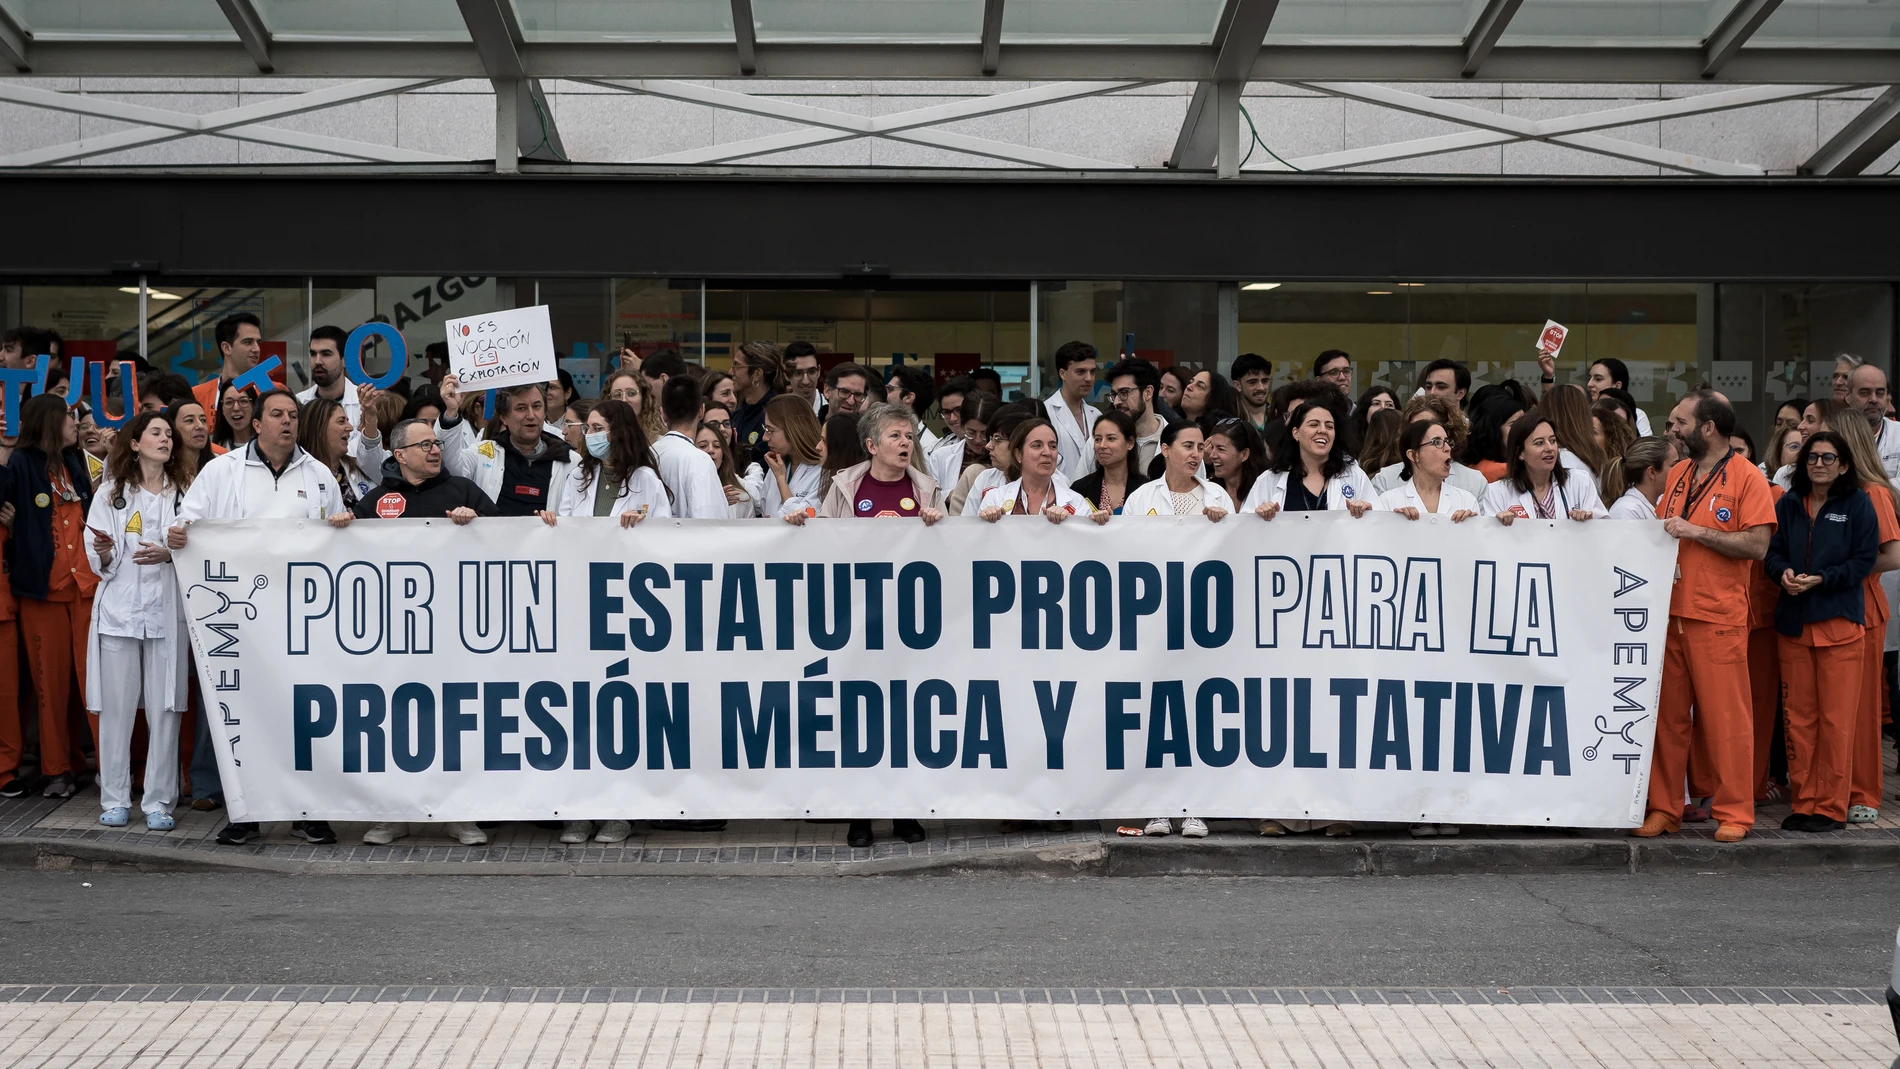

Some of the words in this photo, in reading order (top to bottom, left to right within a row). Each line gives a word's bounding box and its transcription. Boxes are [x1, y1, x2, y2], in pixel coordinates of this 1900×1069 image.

[452, 322, 470, 339] NO
[477, 321, 498, 332] ES
[1549, 329, 1563, 339] STOP
[478, 352, 496, 363] ES
[287, 561, 434, 655] POR
[459, 560, 557, 653] UN
[589, 561, 942, 652] ESTATUTO
[972, 560, 1234, 651] PROPIO
[1255, 555, 1445, 652] PARA
[1469, 560, 1558, 657] LA
[293, 657, 691, 773] PROFESIÓN
[720, 656, 1007, 769] MÉDICA
[1033, 680, 1077, 770] Y
[1105, 677, 1571, 776] FACULTATIVA
